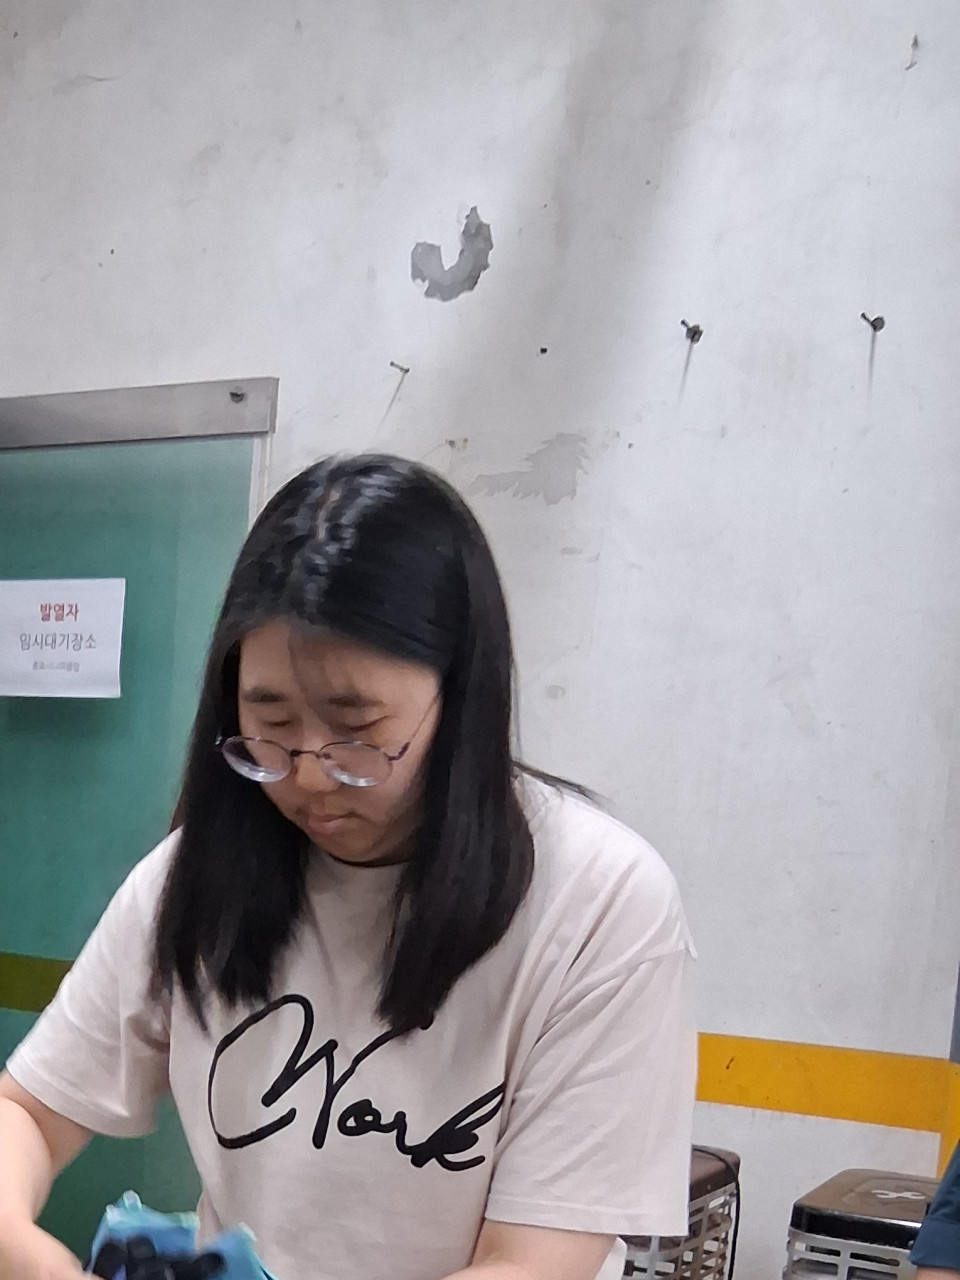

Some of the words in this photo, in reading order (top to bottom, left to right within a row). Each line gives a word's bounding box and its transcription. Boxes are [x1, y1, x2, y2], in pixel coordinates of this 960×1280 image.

[40, 603, 79, 622] 발열자
[19, 632, 97, 651] 임시대기장소
[208, 994, 507, 1171] Work
